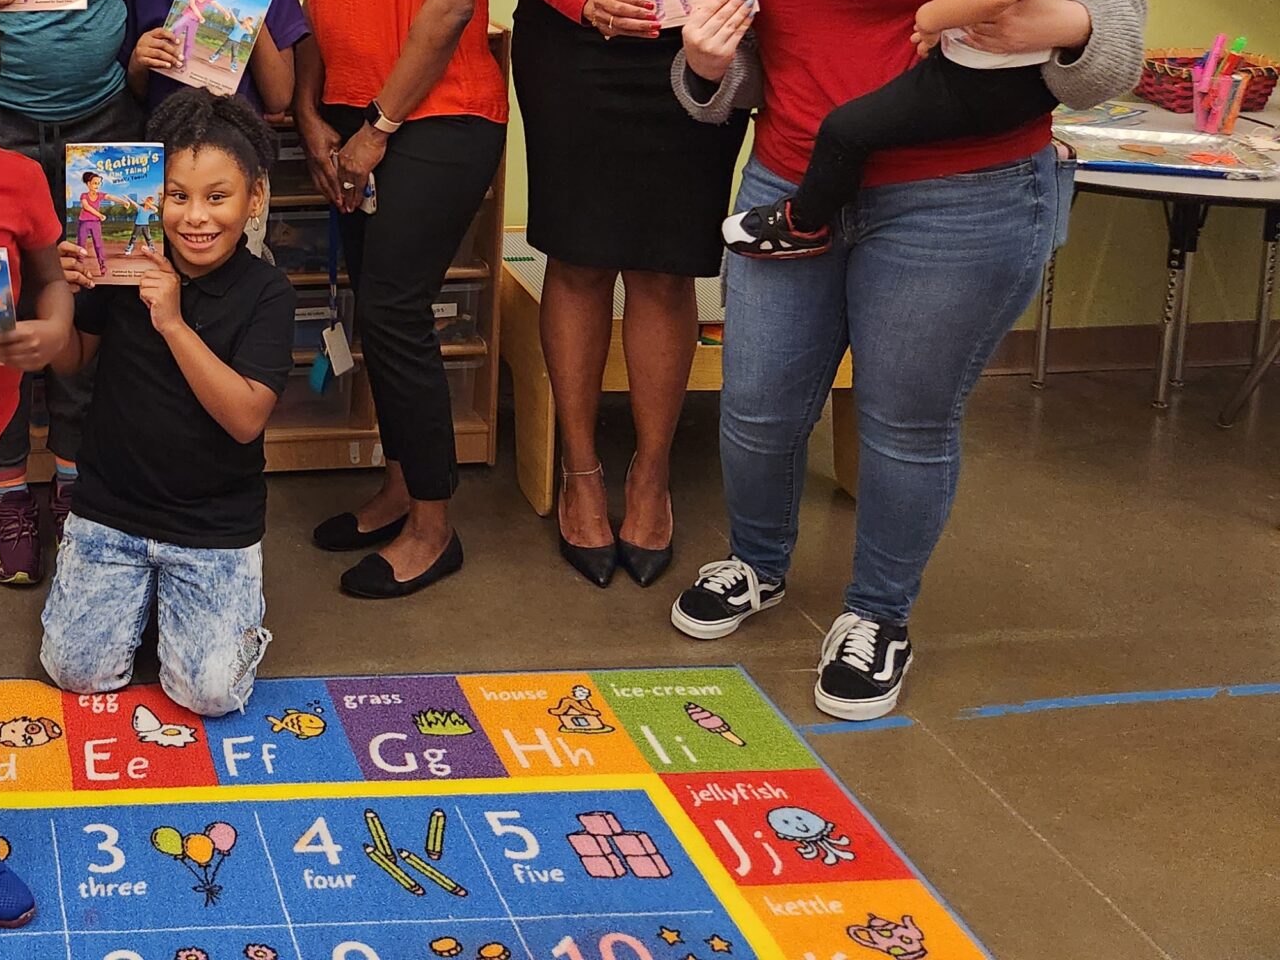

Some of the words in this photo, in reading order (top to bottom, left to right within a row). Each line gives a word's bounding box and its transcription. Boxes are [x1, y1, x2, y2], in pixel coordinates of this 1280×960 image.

[96, 150, 159, 171] Skating's
[343, 692, 403, 709] grass
[479, 686, 548, 702] house
[610, 683, 723, 698] ice-cream
[78, 693, 119, 714] egg
[686, 781, 789, 807] jellyfish
[293, 816, 343, 865] 4
[483, 810, 540, 860] 5
[82, 824, 126, 874] 3
[303, 868, 357, 890] four
[511, 863, 565, 884] five
[78, 877, 148, 899] three
[763, 895, 846, 916] kettle
